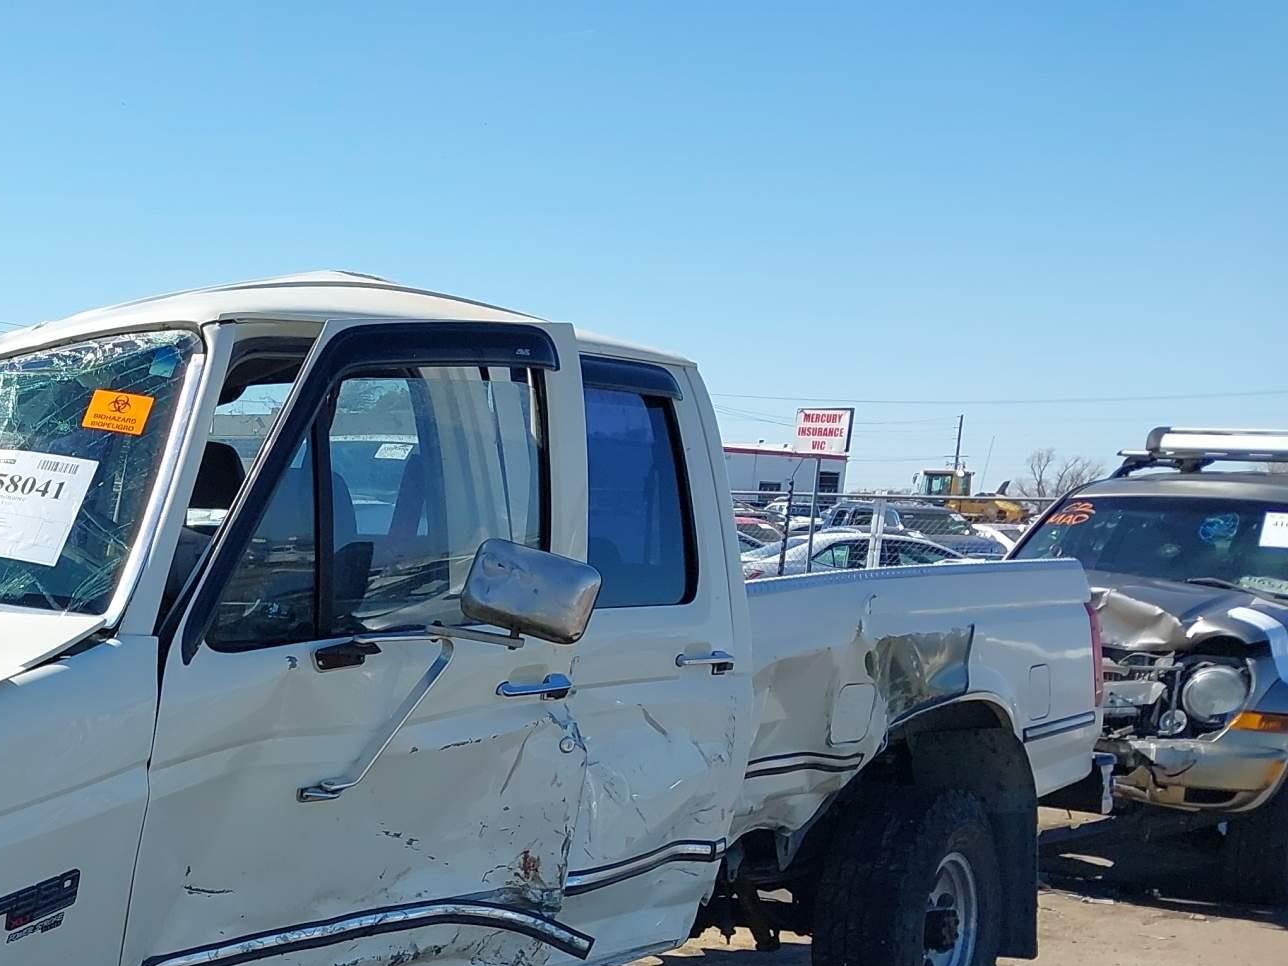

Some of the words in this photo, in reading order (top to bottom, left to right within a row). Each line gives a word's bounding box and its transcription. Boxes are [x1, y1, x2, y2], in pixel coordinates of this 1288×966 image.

[93, 413, 137, 424] BIOHAZARD
[803, 413, 843, 424] MERCURY
[90, 421, 135, 432] BIOPELIGRO
[797, 426, 845, 437] INSURANCE
[811, 440, 827, 451] VIC
